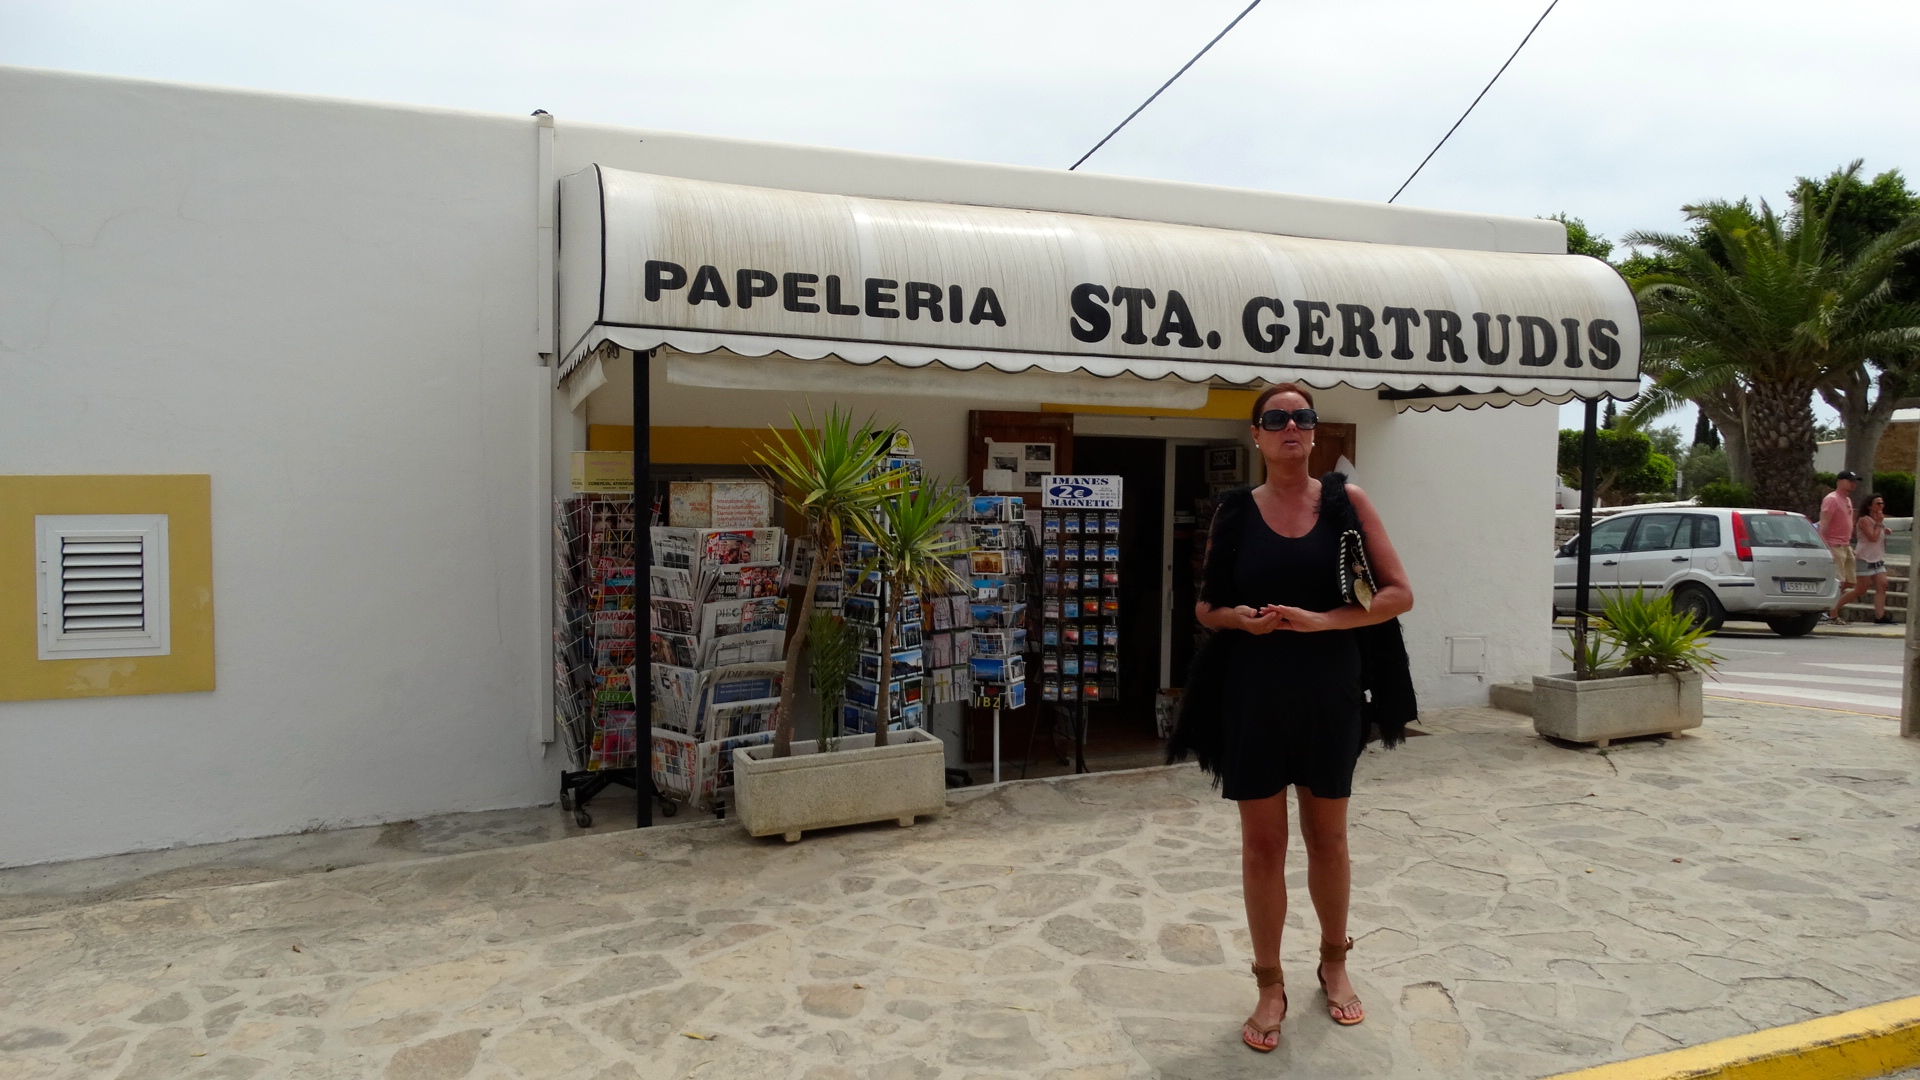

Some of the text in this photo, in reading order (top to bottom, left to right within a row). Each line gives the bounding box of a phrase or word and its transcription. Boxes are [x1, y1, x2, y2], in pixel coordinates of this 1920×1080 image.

[644, 259, 1621, 370] PAPELERIA STA. GERTRUDIS
[1052, 477, 1109, 486] IMANES
[1058, 486, 1085, 498] 2€
[1050, 499, 1113, 508] MAGNETIC
